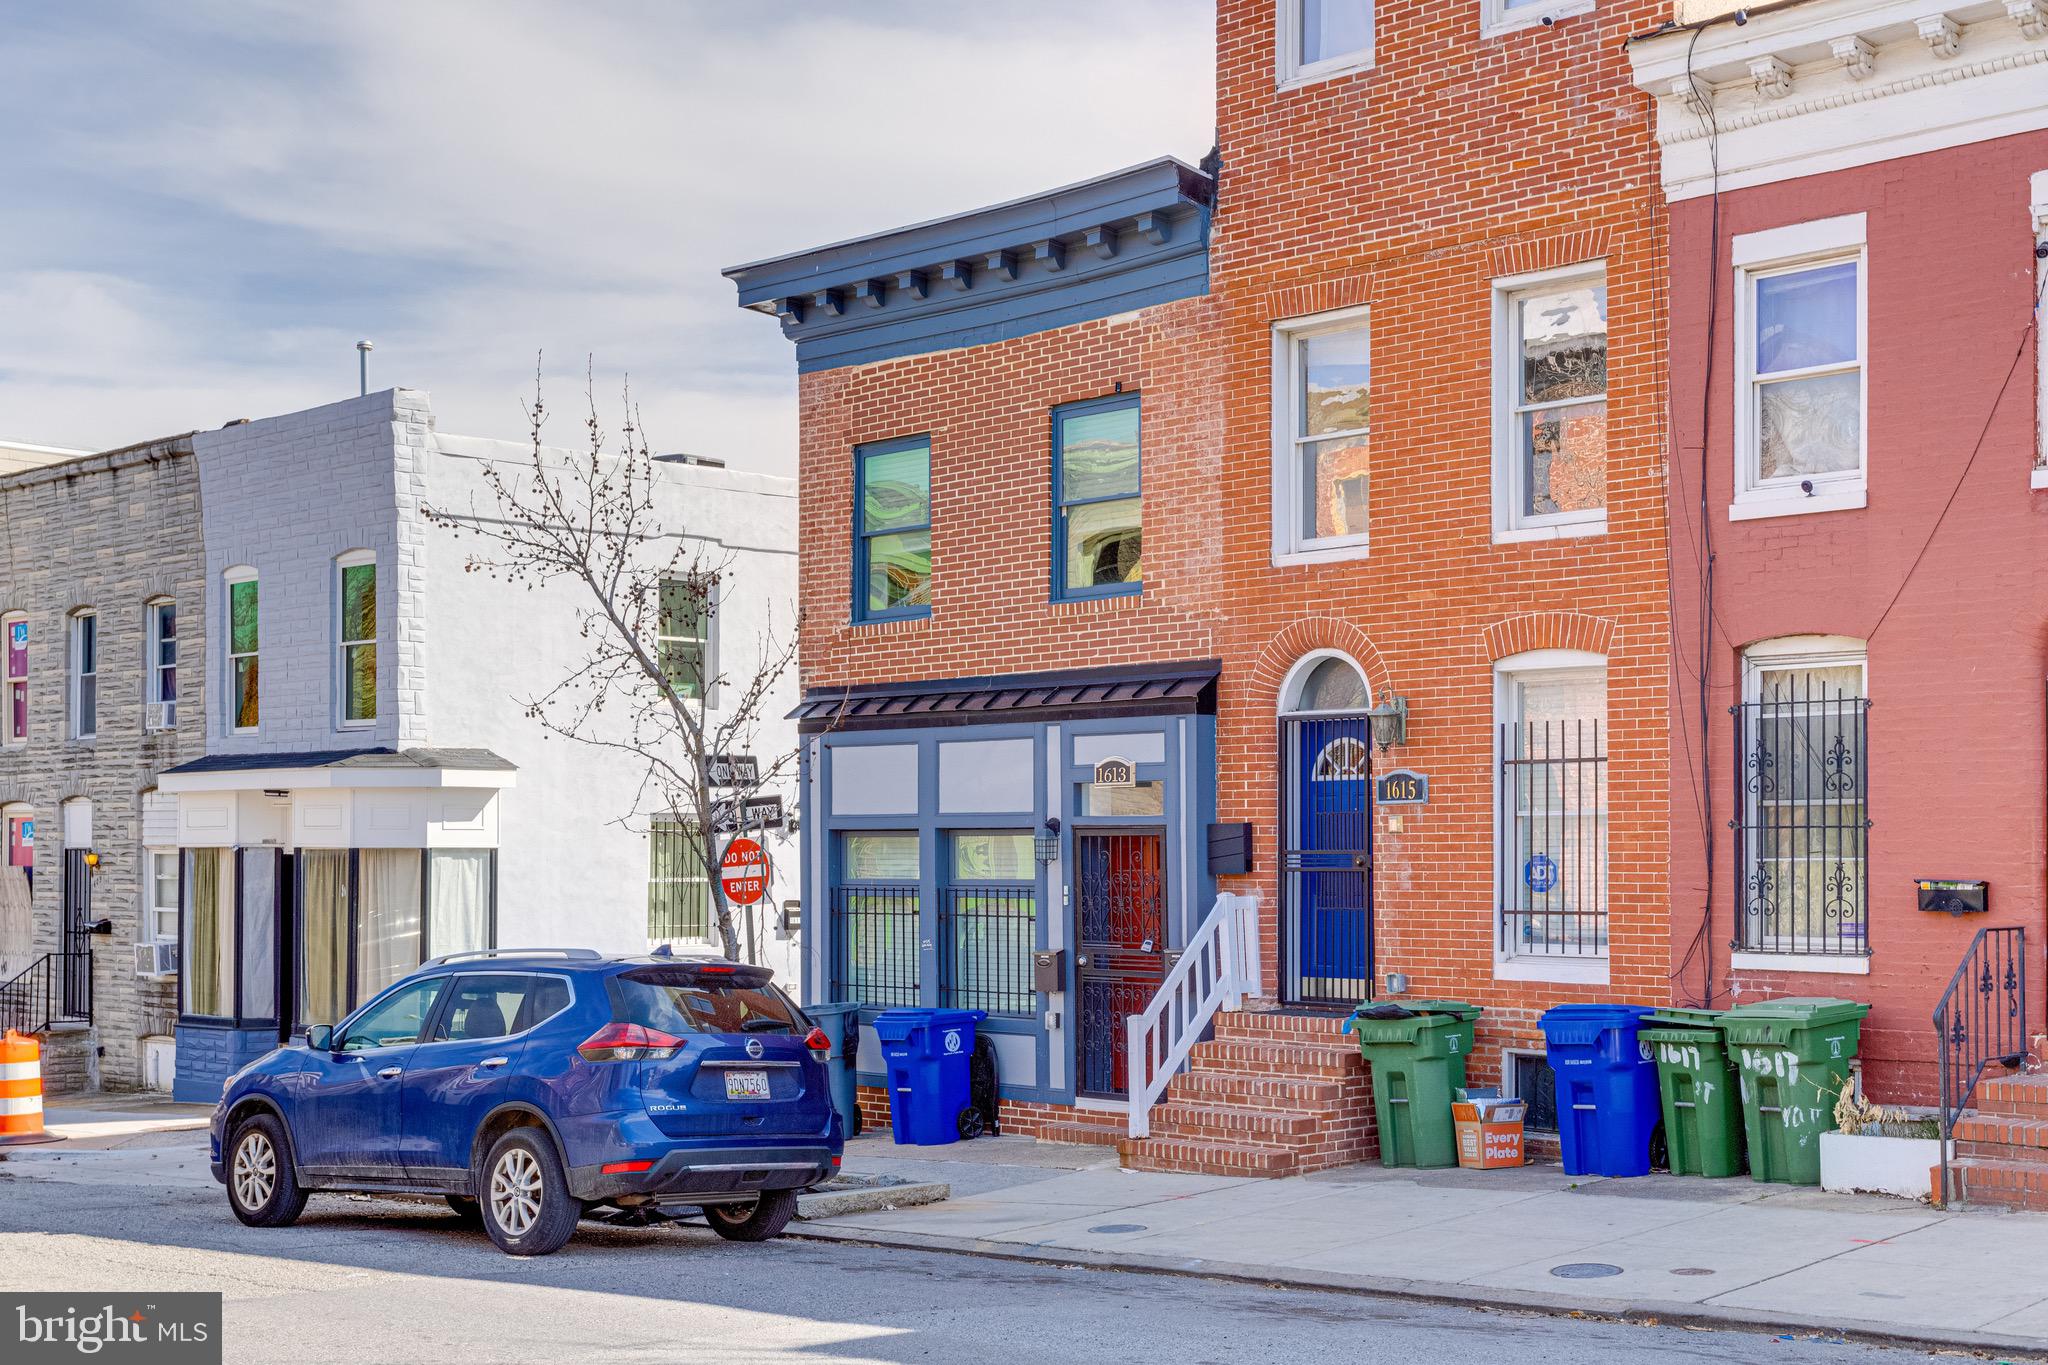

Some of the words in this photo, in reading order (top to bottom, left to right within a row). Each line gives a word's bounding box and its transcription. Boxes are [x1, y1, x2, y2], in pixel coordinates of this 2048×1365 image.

[1098, 767, 1126, 782] 1613
[1386, 781, 1416, 799] 1615
[752, 805, 773, 820] WAY
[725, 852, 738, 864] DO
[742, 851, 761, 862] NOT
[1529, 865, 1554, 880] ADT
[730, 881, 760, 893] ENTER
[1485, 1132, 1520, 1146] Every
[1486, 1146, 1518, 1159] Plate
